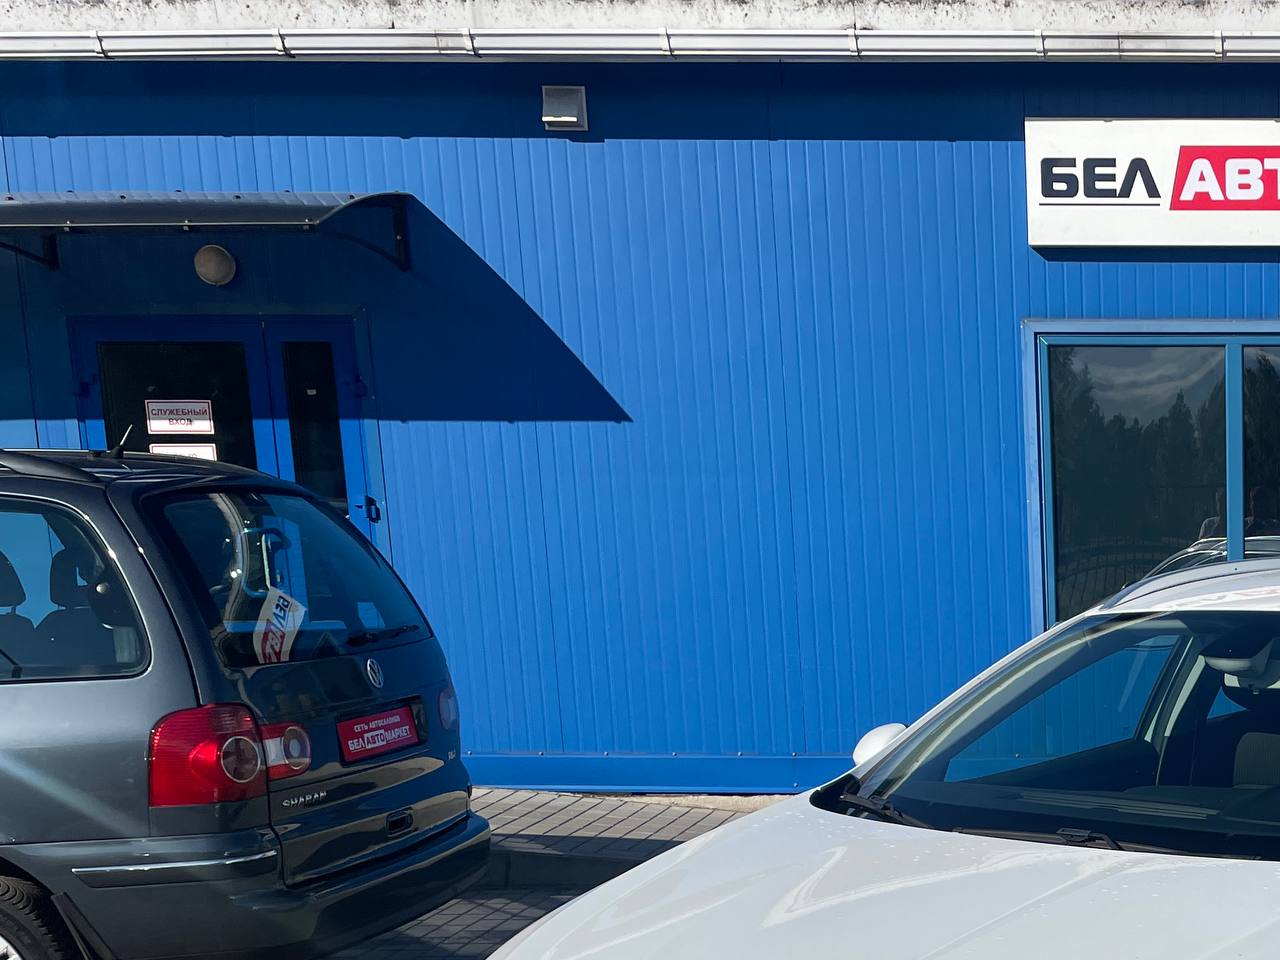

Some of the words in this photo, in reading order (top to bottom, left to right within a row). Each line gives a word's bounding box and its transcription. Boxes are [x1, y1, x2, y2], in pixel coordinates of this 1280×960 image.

[1040, 157, 1161, 199] БЕЛ
[150, 407, 208, 416] СЛУЖЕБНЫЙ
[168, 418, 193, 426] ВХОД
[348, 738, 365, 751] БЕЛ
[366, 732, 385, 746] АВТО
